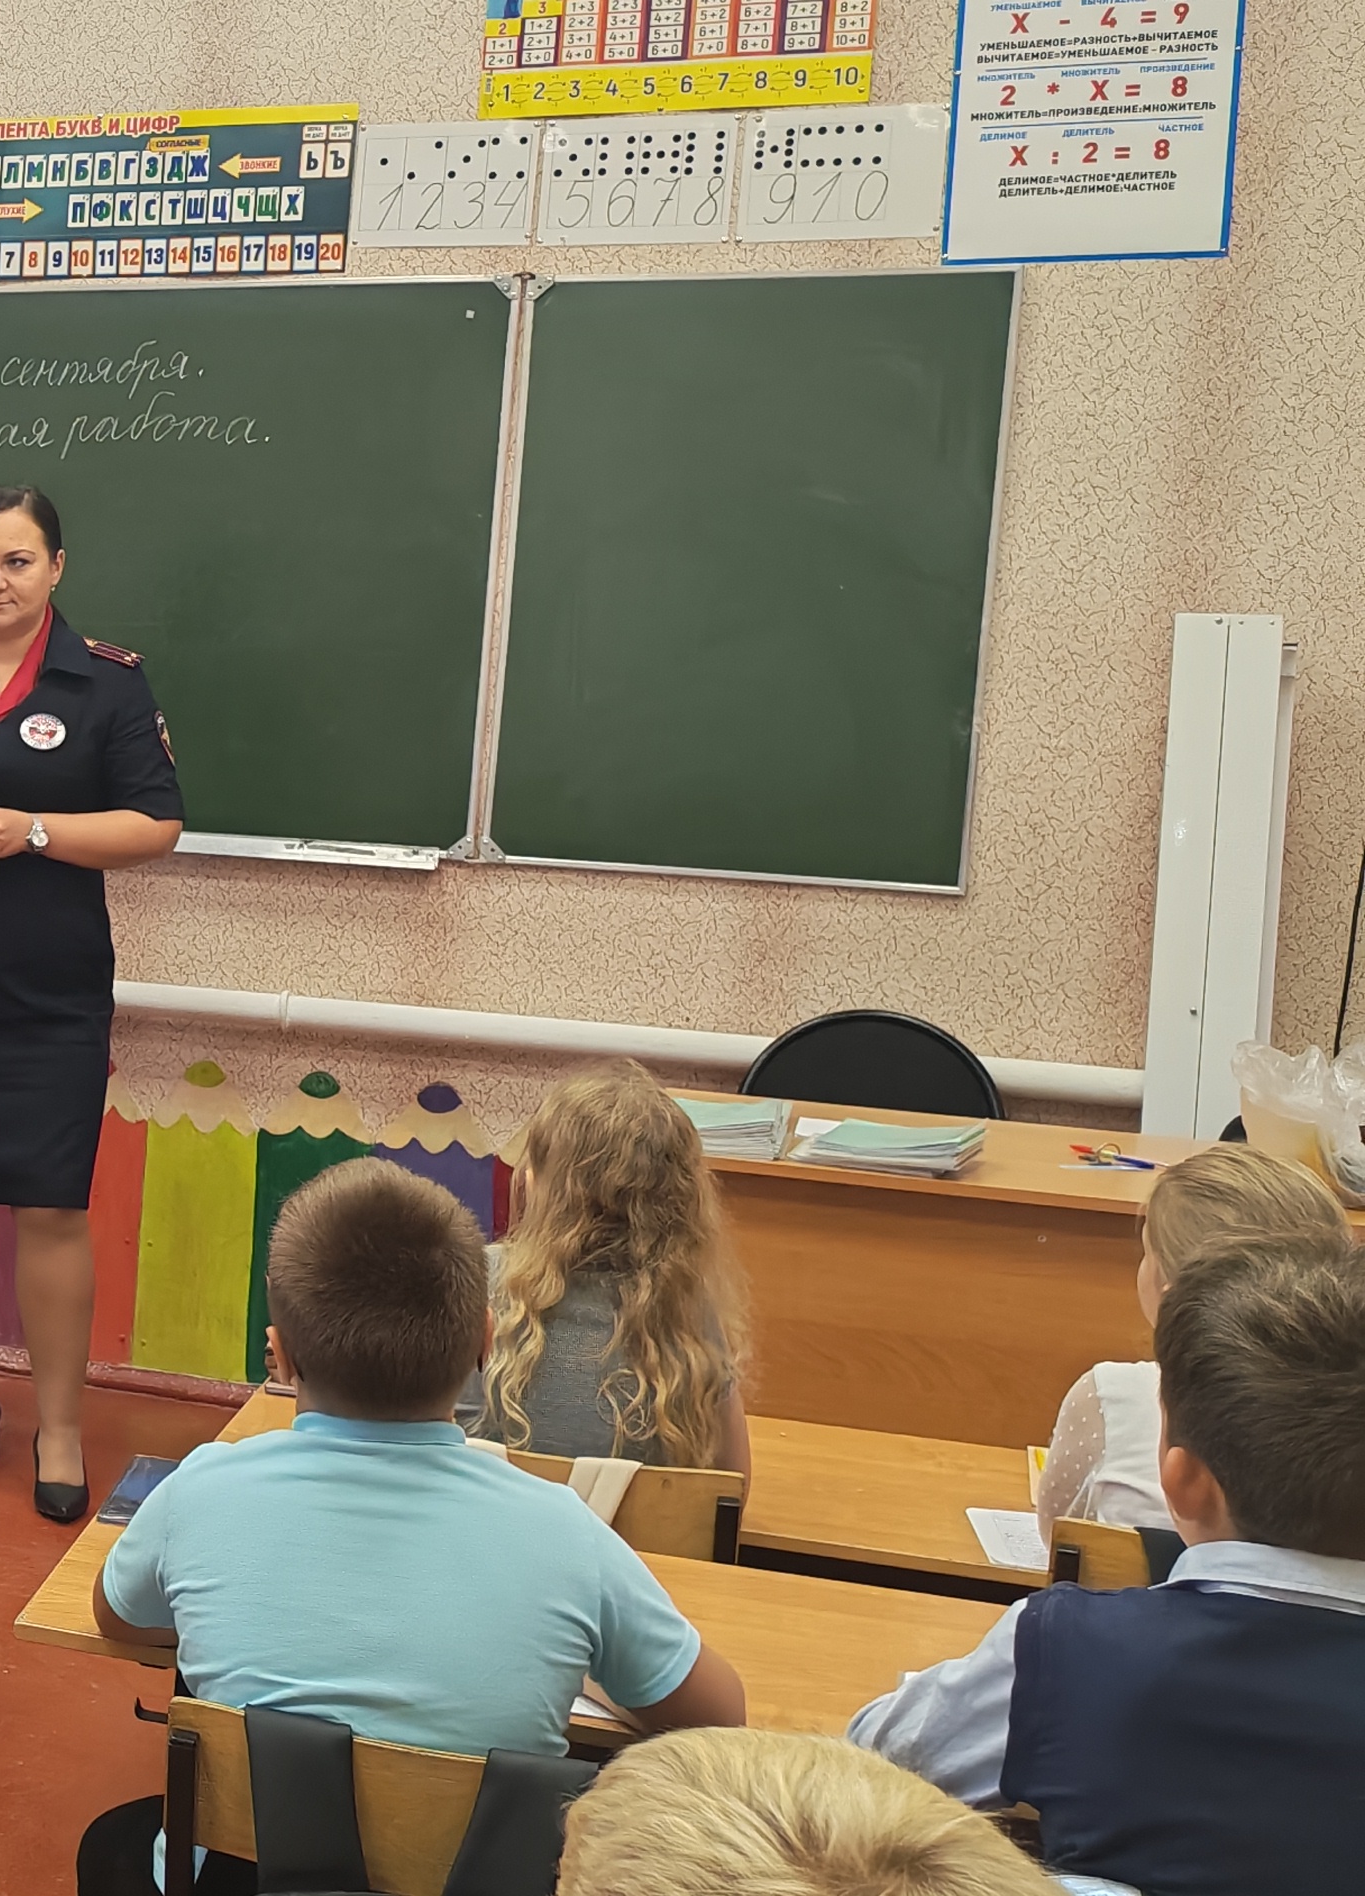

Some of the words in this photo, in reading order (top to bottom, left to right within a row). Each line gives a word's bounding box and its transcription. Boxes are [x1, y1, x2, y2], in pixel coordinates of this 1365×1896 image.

[991, 0, 1062, 11] УМЕНЬШАЕМОЕ
[1101, 6, 1117, 28] 4
[1173, 3, 1190, 24] 9
[1159, 42, 1219, 54] РАЗНОСТЬ
[503, 84, 510, 102] 1
[533, 82, 545, 100] 2
[569, 80, 581, 98] 3
[605, 79, 619, 96] 4
[643, 77, 656, 95] 5
[680, 75, 693, 93] 6
[718, 73, 729, 91] 7
[755, 71, 768, 89] 8
[794, 69, 807, 88] 9
[833, 67, 858, 86] 10
[1061, 67, 1121, 78] МНОЖИТЕЛЬ
[1140, 63, 1215, 74] ПРОИЗВЕДЕНИЕ
[1000, 85, 1017, 106] 2
[1171, 76, 1188, 97] 8
[56, 119, 103, 137] БУКВ
[108, 118, 119, 134] И
[125, 116, 180, 137] ЦИФР
[979, 131, 1028, 142] ДЕЛИМОЕ
[1062, 127, 1115, 138] ДЕЛИТЕЛЬ
[1158, 123, 1204, 132] ЧАСТНОЕ
[1082, 142, 1099, 163] 2
[1153, 139, 1170, 160] 8
[5, 164, 19, 183] Л
[27, 162, 43, 182] М
[53, 162, 65, 182] Н
[75, 160, 89, 180] Б
[98, 159, 112, 180] В
[124, 158, 136, 178] Г
[145, 157, 158, 177] З
[168, 155, 183, 180] Д
[188, 154, 209, 176] Ж
[306, 151, 319, 171] Ь
[330, 150, 345, 170] Ъ
[72, 202, 86, 223] П
[93, 200, 111, 221] Ф
[119, 200, 133, 221] К
[145, 199, 156, 220] С
[168, 198, 181, 219] Т
[187, 198, 205, 219] Ш
[212, 196, 227, 222] Ц
[238, 196, 250, 217] Ч
[257, 195, 277, 220] Щ
[285, 195, 299, 216] Х
[378, 183, 404, 231] 1
[415, 183, 444, 230] 2
[454, 182, 486, 229] 3
[494, 181, 528, 228] 4
[558, 180, 594, 228] 5
[607, 179, 637, 227] 6
[653, 177, 681, 227] 7
[693, 176, 724, 226] 8
[763, 173, 797, 224] 9
[5, 252, 15, 268] 7
[28, 251, 38, 268] 8
[52, 251, 62, 267] 9
[72, 250, 89, 266] 10
[98, 250, 114, 266] 11
[122, 248, 140, 265] 12
[145, 248, 163, 265] 13
[170, 247, 187, 263] 14
[193, 246, 212, 262] 15
[219, 245, 237, 262] 16
[244, 244, 263, 261] 17
[269, 244, 287, 260] 18
[295, 243, 314, 260] 19
[320, 243, 341, 260] 20
[0, 340, 205, 400] сентября.
[60, 391, 271, 460] работа.
